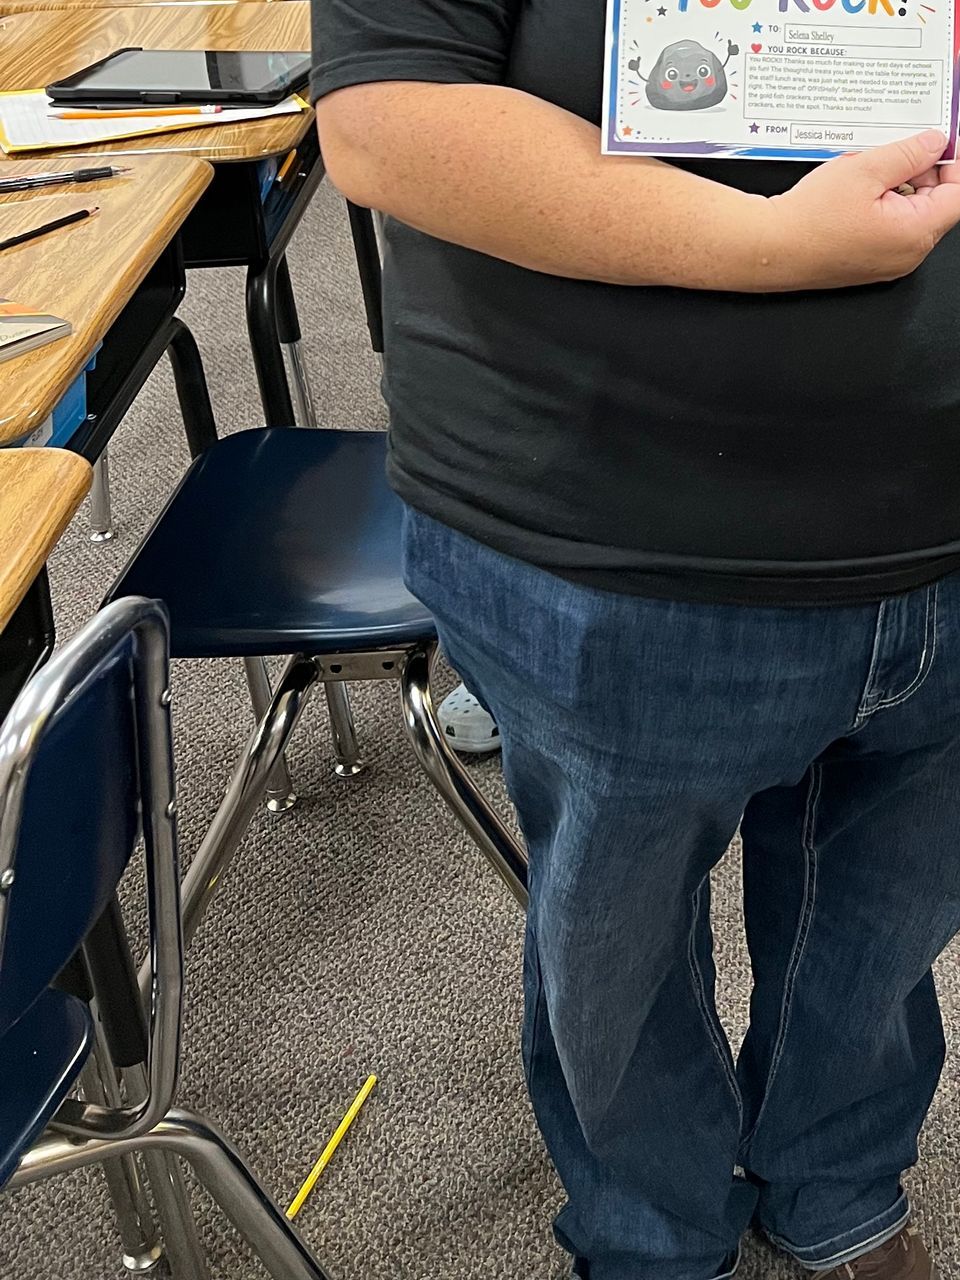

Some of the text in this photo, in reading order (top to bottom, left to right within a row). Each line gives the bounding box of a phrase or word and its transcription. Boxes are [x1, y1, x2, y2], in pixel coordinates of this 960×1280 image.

[789, 30, 834, 43] Selena Shelley
[786, 47, 807, 55] ROCK
[810, 48, 847, 56] BECAUSE:
[795, 129, 853, 140] Jessica Howard
